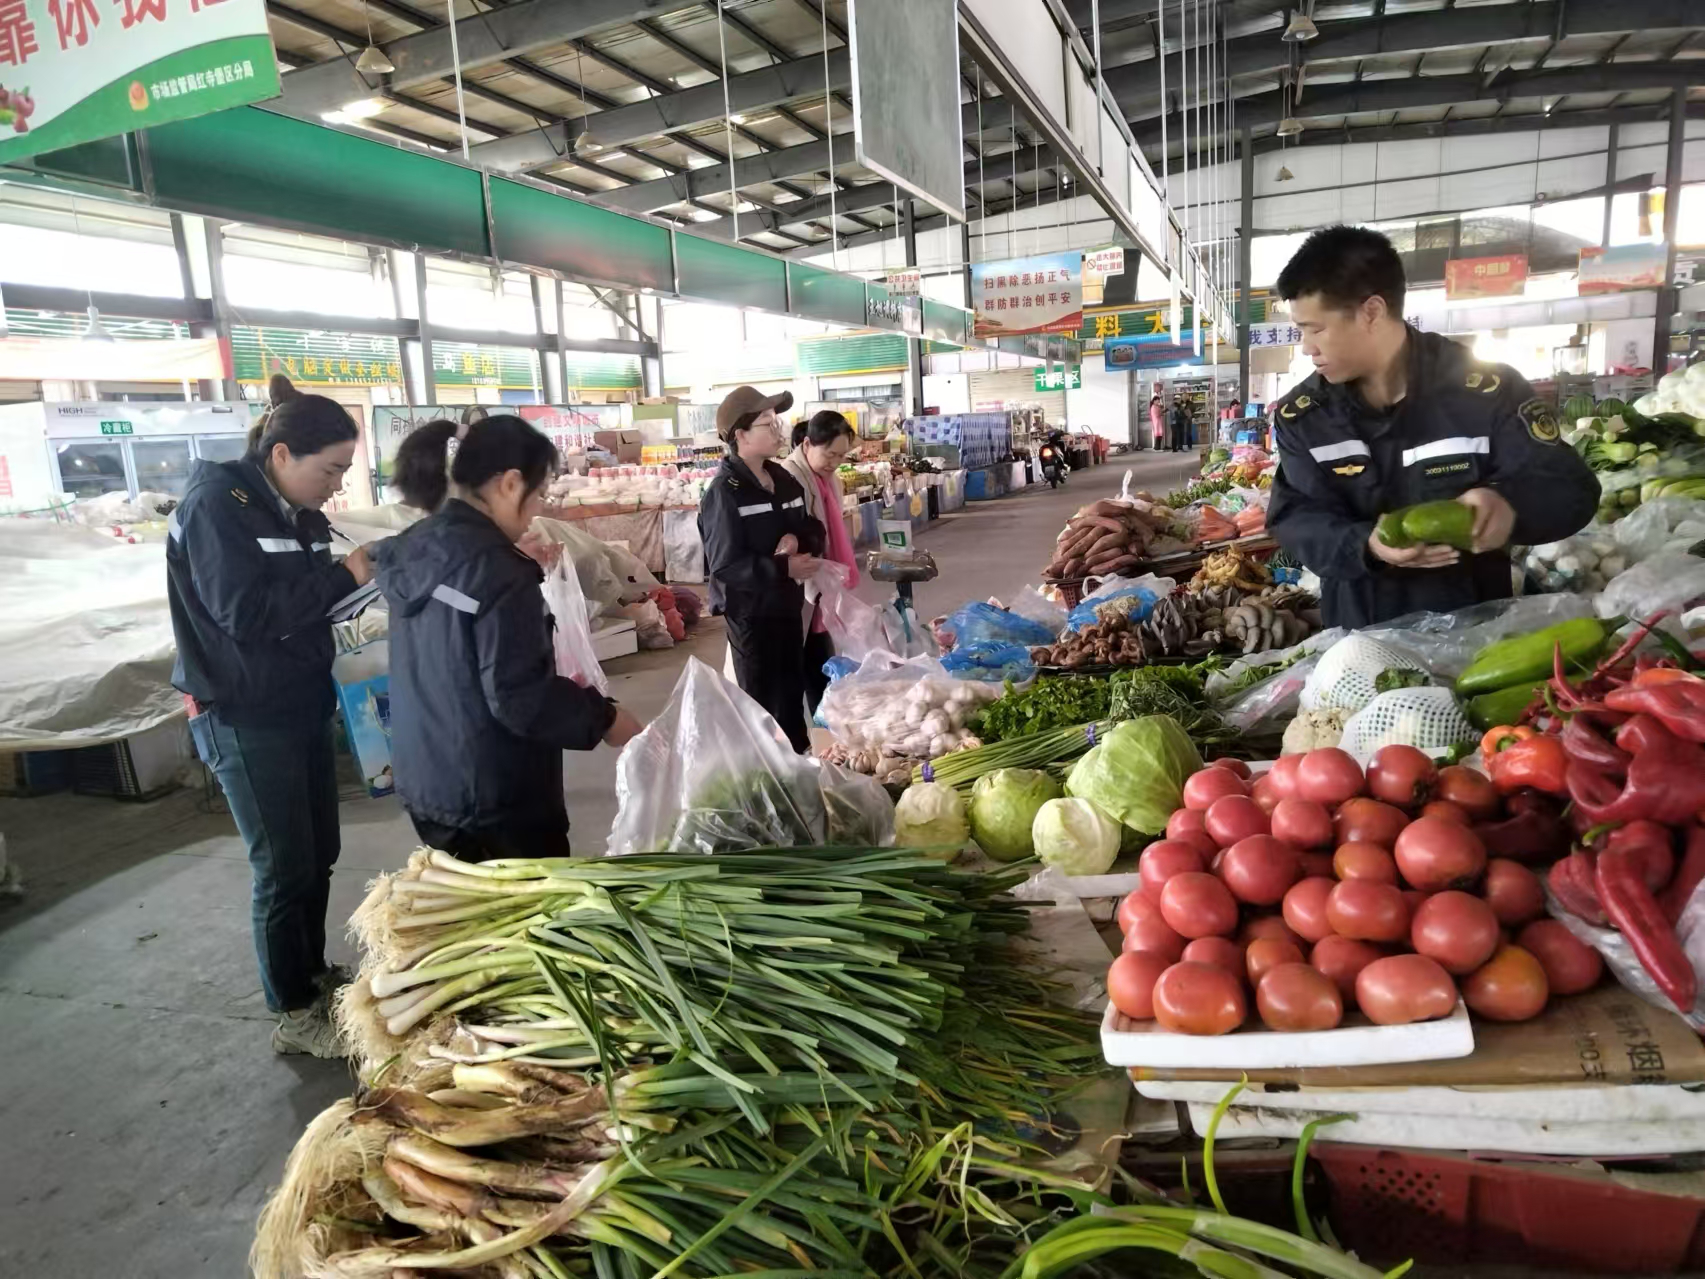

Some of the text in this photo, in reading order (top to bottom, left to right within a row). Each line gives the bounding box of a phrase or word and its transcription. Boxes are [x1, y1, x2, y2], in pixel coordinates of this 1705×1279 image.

[0, 0, 230, 66] 靠你
[984, 269, 1071, 290] 扫黑除恶扬正气
[984, 291, 1071, 311] 群防群治创平安
